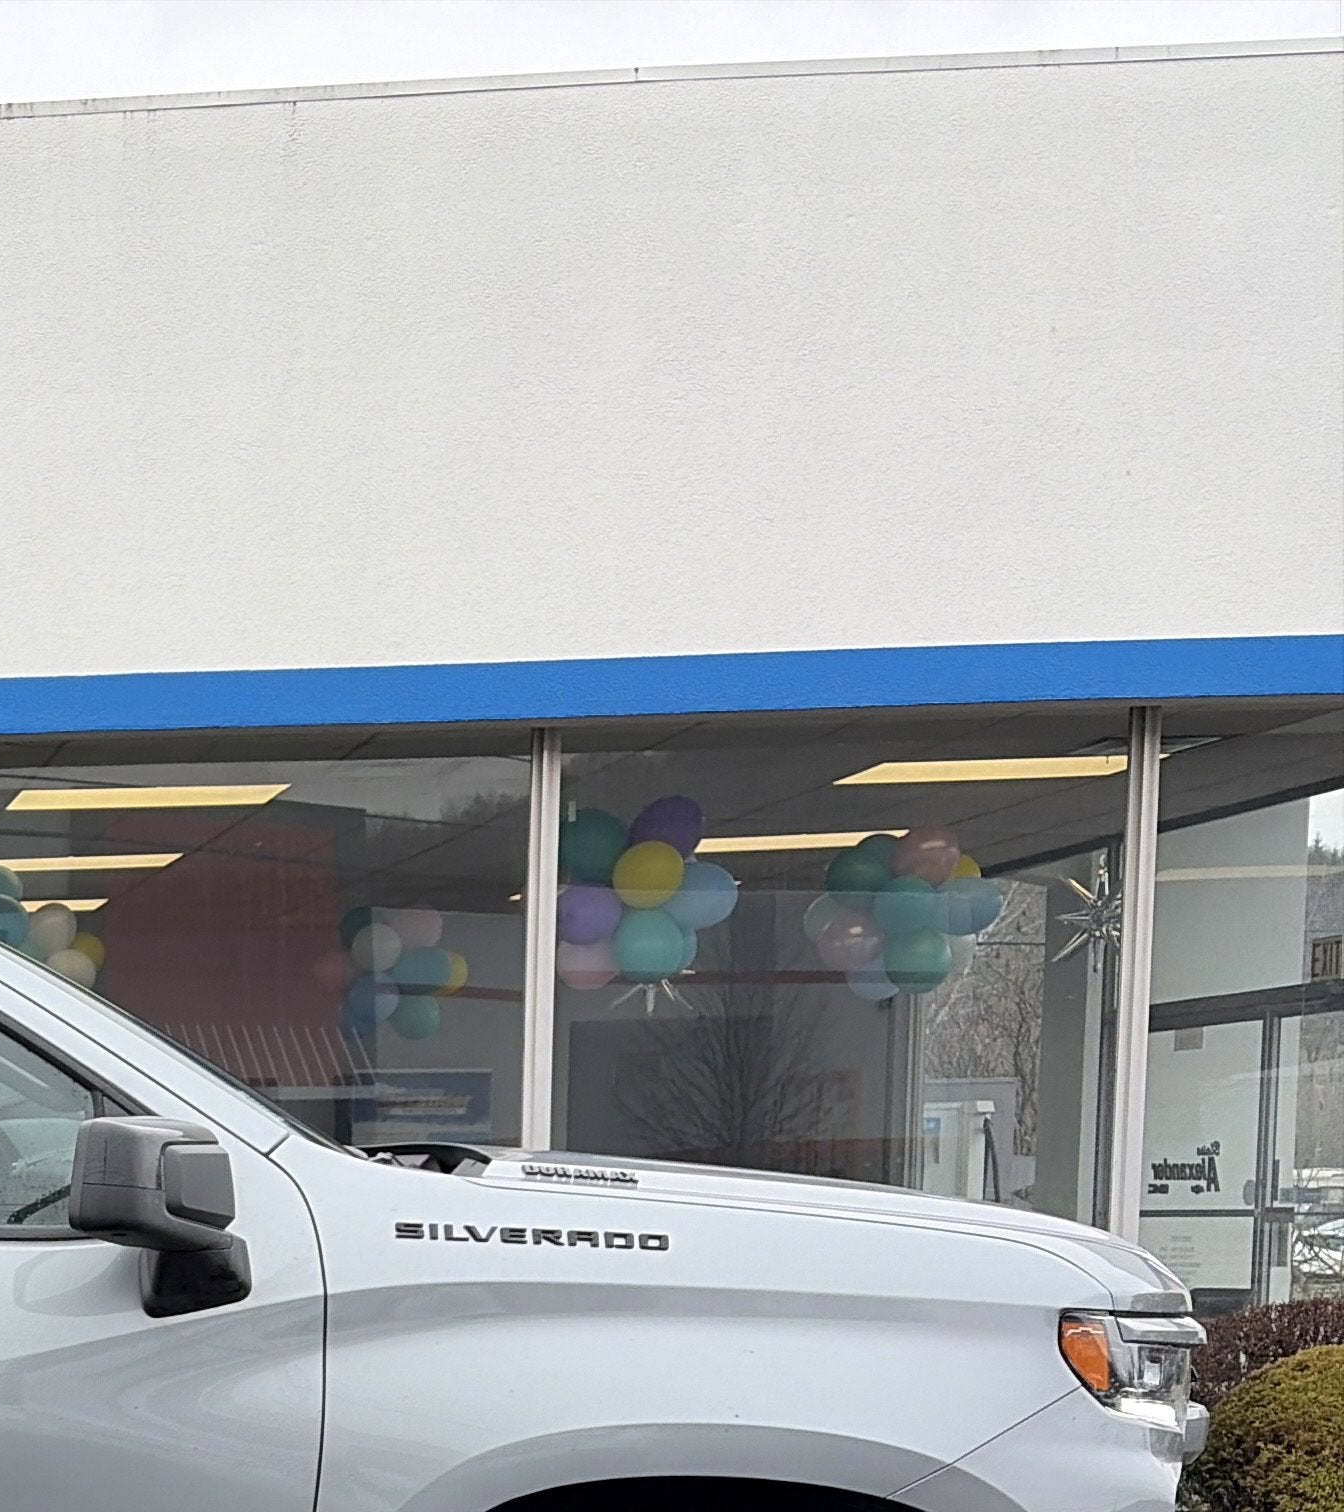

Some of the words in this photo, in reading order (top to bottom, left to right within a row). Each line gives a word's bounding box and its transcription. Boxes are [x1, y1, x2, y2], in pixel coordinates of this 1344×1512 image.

[1311, 940, 1342, 977] EXIT
[520, 1164, 640, 1184] DURAMAX
[394, 1221, 670, 1252] SILVERADO
